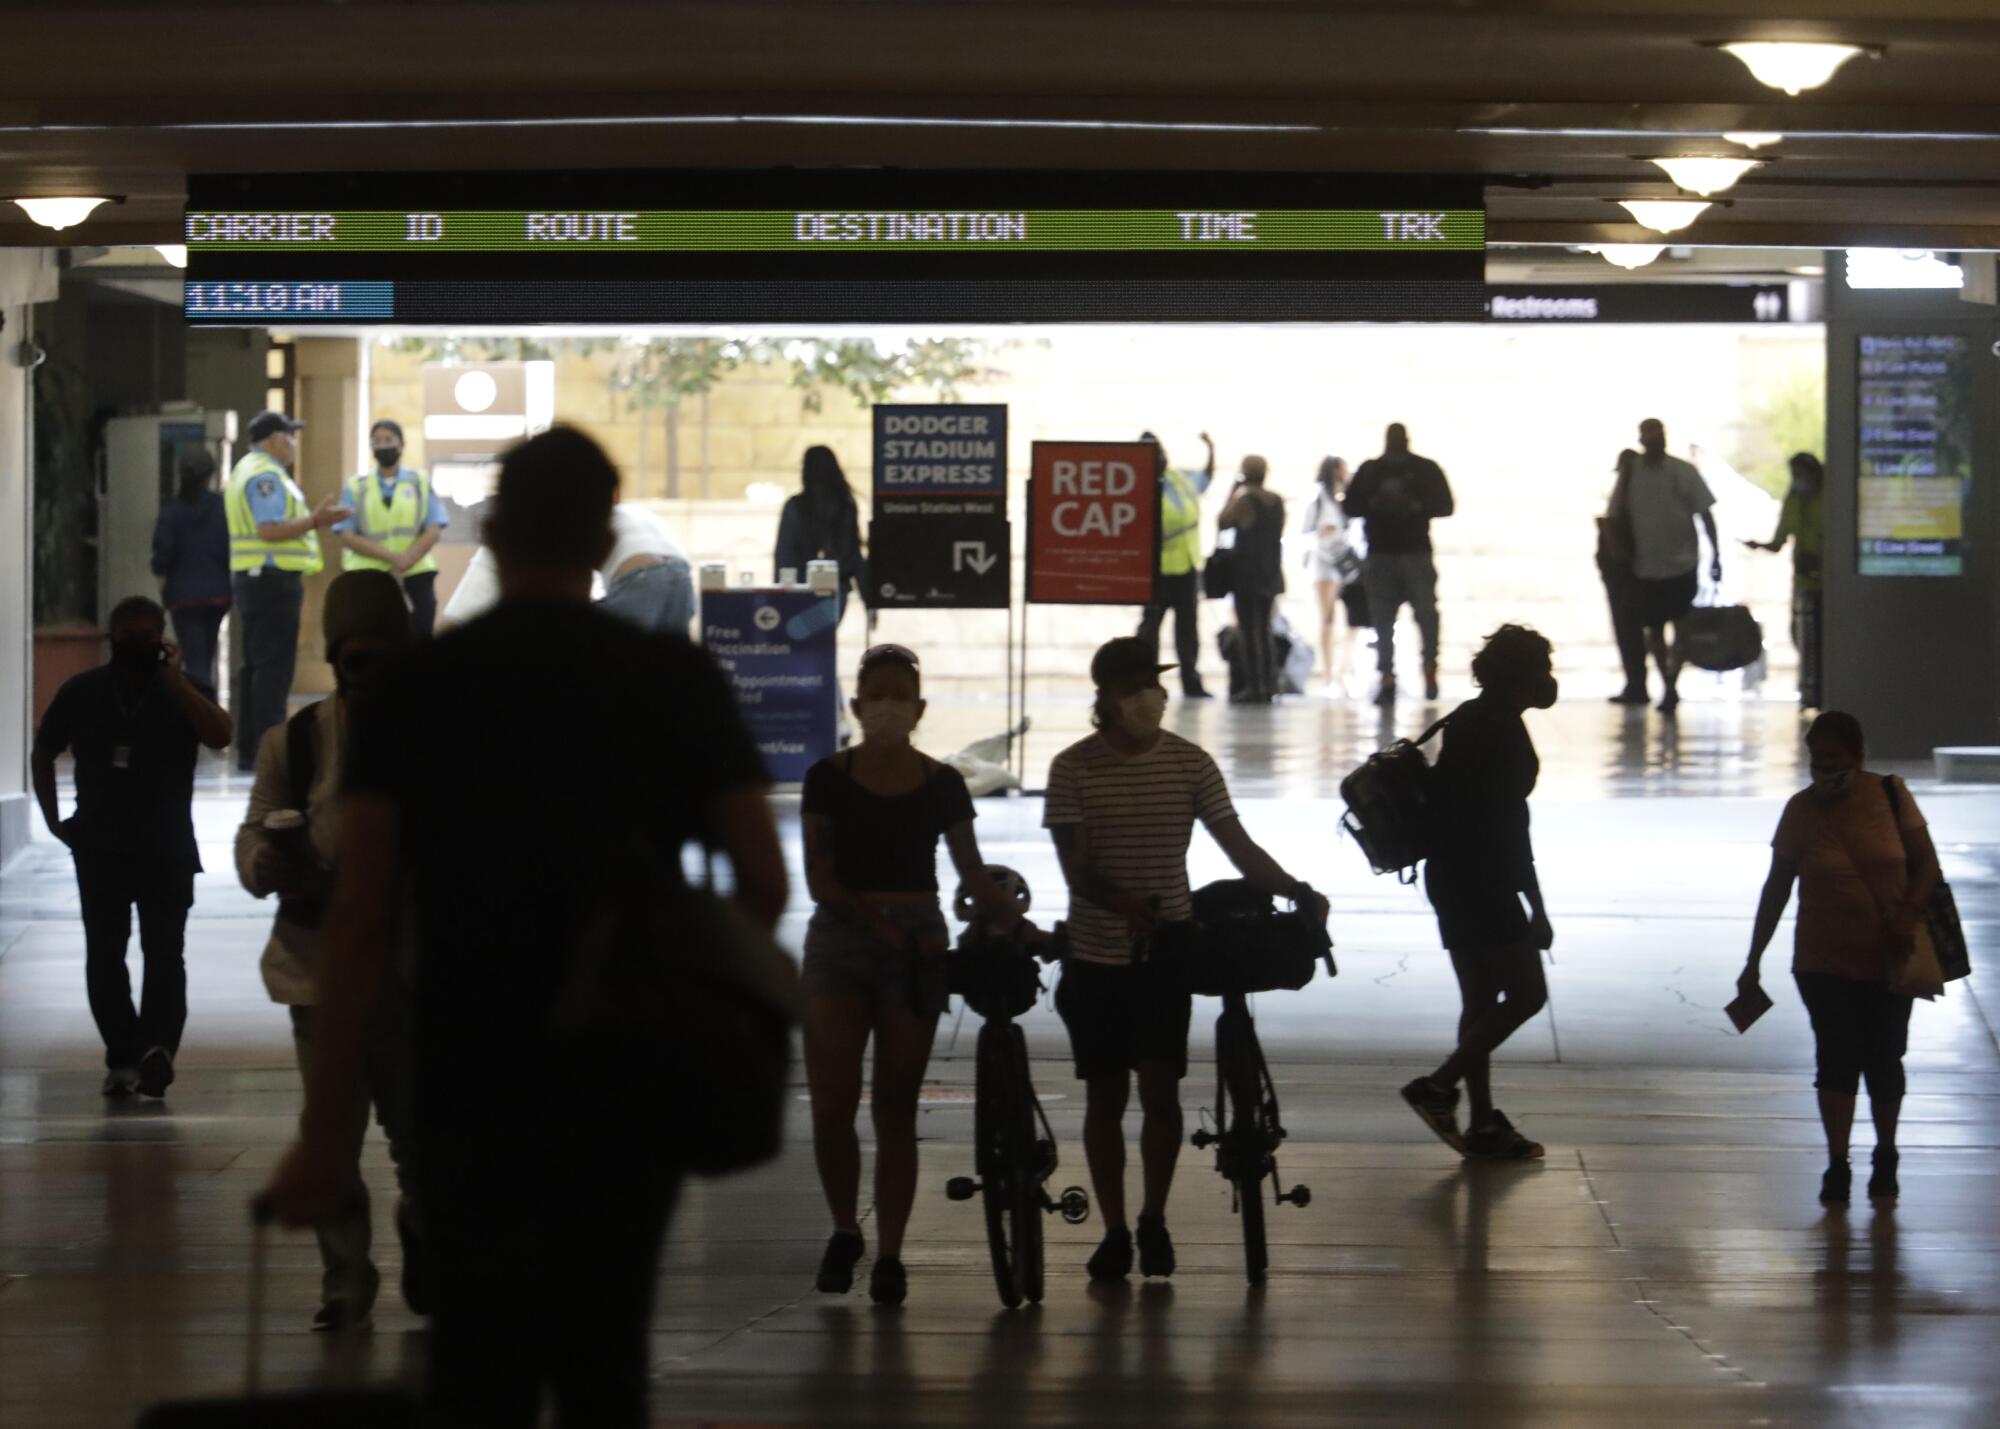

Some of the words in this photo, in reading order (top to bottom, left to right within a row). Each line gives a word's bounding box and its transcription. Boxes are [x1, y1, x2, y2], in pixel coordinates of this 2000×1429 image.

[186, 214, 336, 241] CARRIER
[405, 214, 443, 241] ID
[525, 214, 638, 241] ROUTE
[794, 213, 1027, 241] DESTINATION
[1177, 213, 1258, 241] TIME
[1380, 213, 1446, 241] TRK
[186, 284, 287, 311] 11:10
[295, 284, 341, 311] AM
[1491, 297, 1598, 319] Restrooms
[885, 416, 989, 435] DODGER
[883, 440, 996, 459] STADIUM
[884, 465, 993, 484] EXPRESS
[1051, 461, 1137, 496] RED
[883, 502, 918, 514] Union
[921, 502, 960, 514] Station
[963, 502, 995, 514] West
[1051, 502, 1137, 537] CAP
[706, 625, 741, 639] Free
